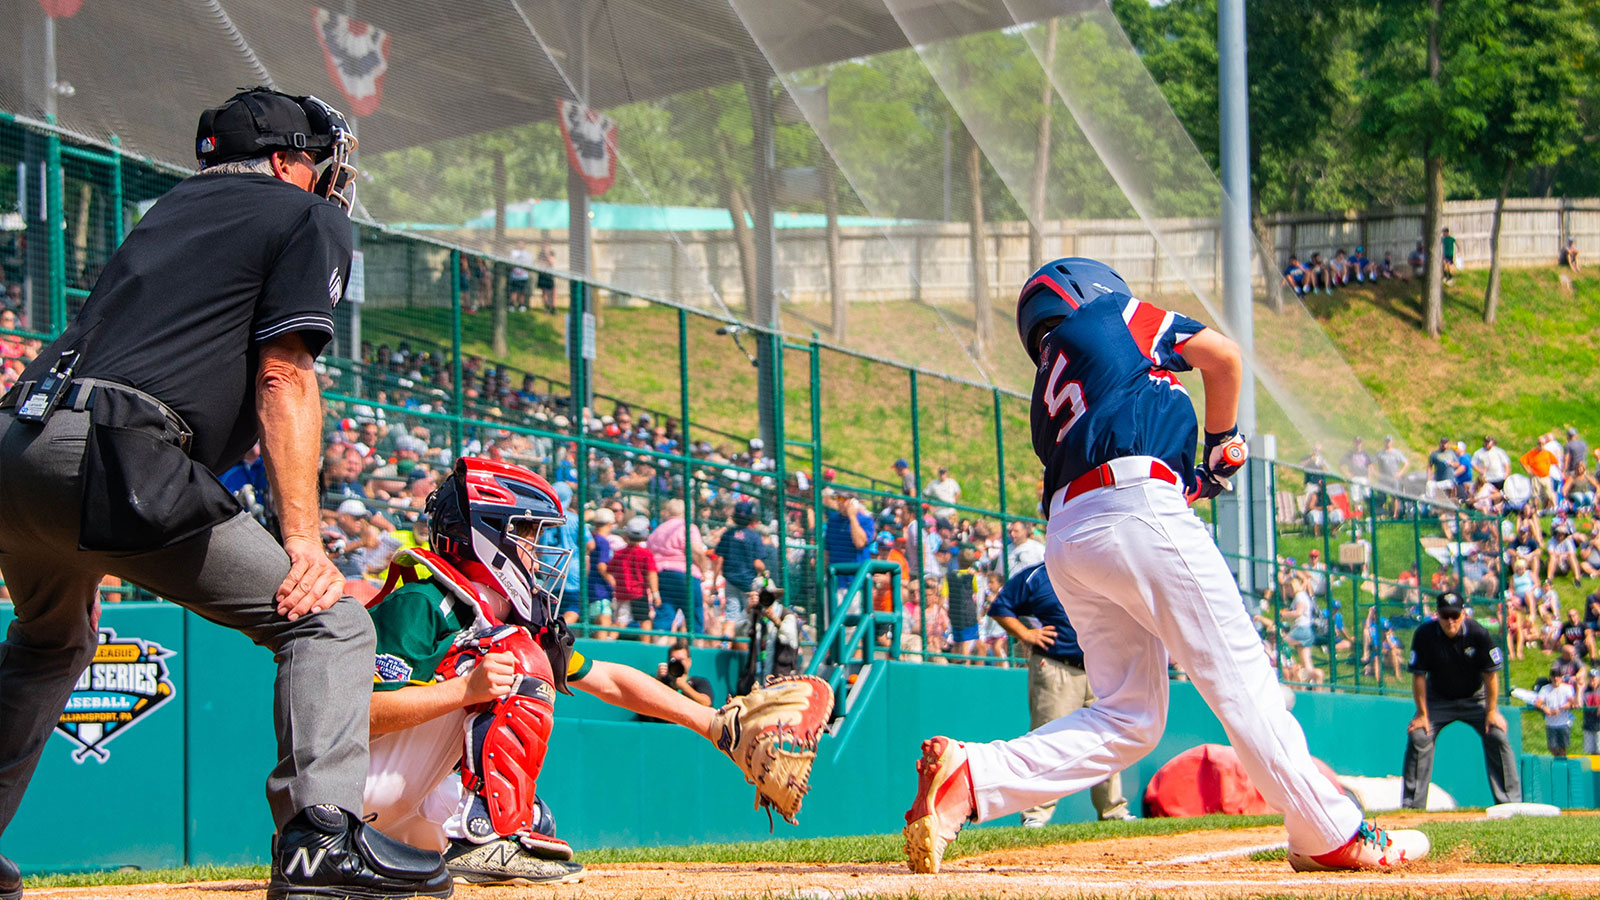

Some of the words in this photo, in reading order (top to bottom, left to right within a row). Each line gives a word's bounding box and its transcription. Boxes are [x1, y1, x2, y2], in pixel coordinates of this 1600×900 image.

[1043, 348, 1089, 445] 5
[95, 648, 135, 658] EAGUE
[92, 663, 158, 696] SERIES
[120, 712, 133, 721] PA
[285, 847, 327, 877] N
